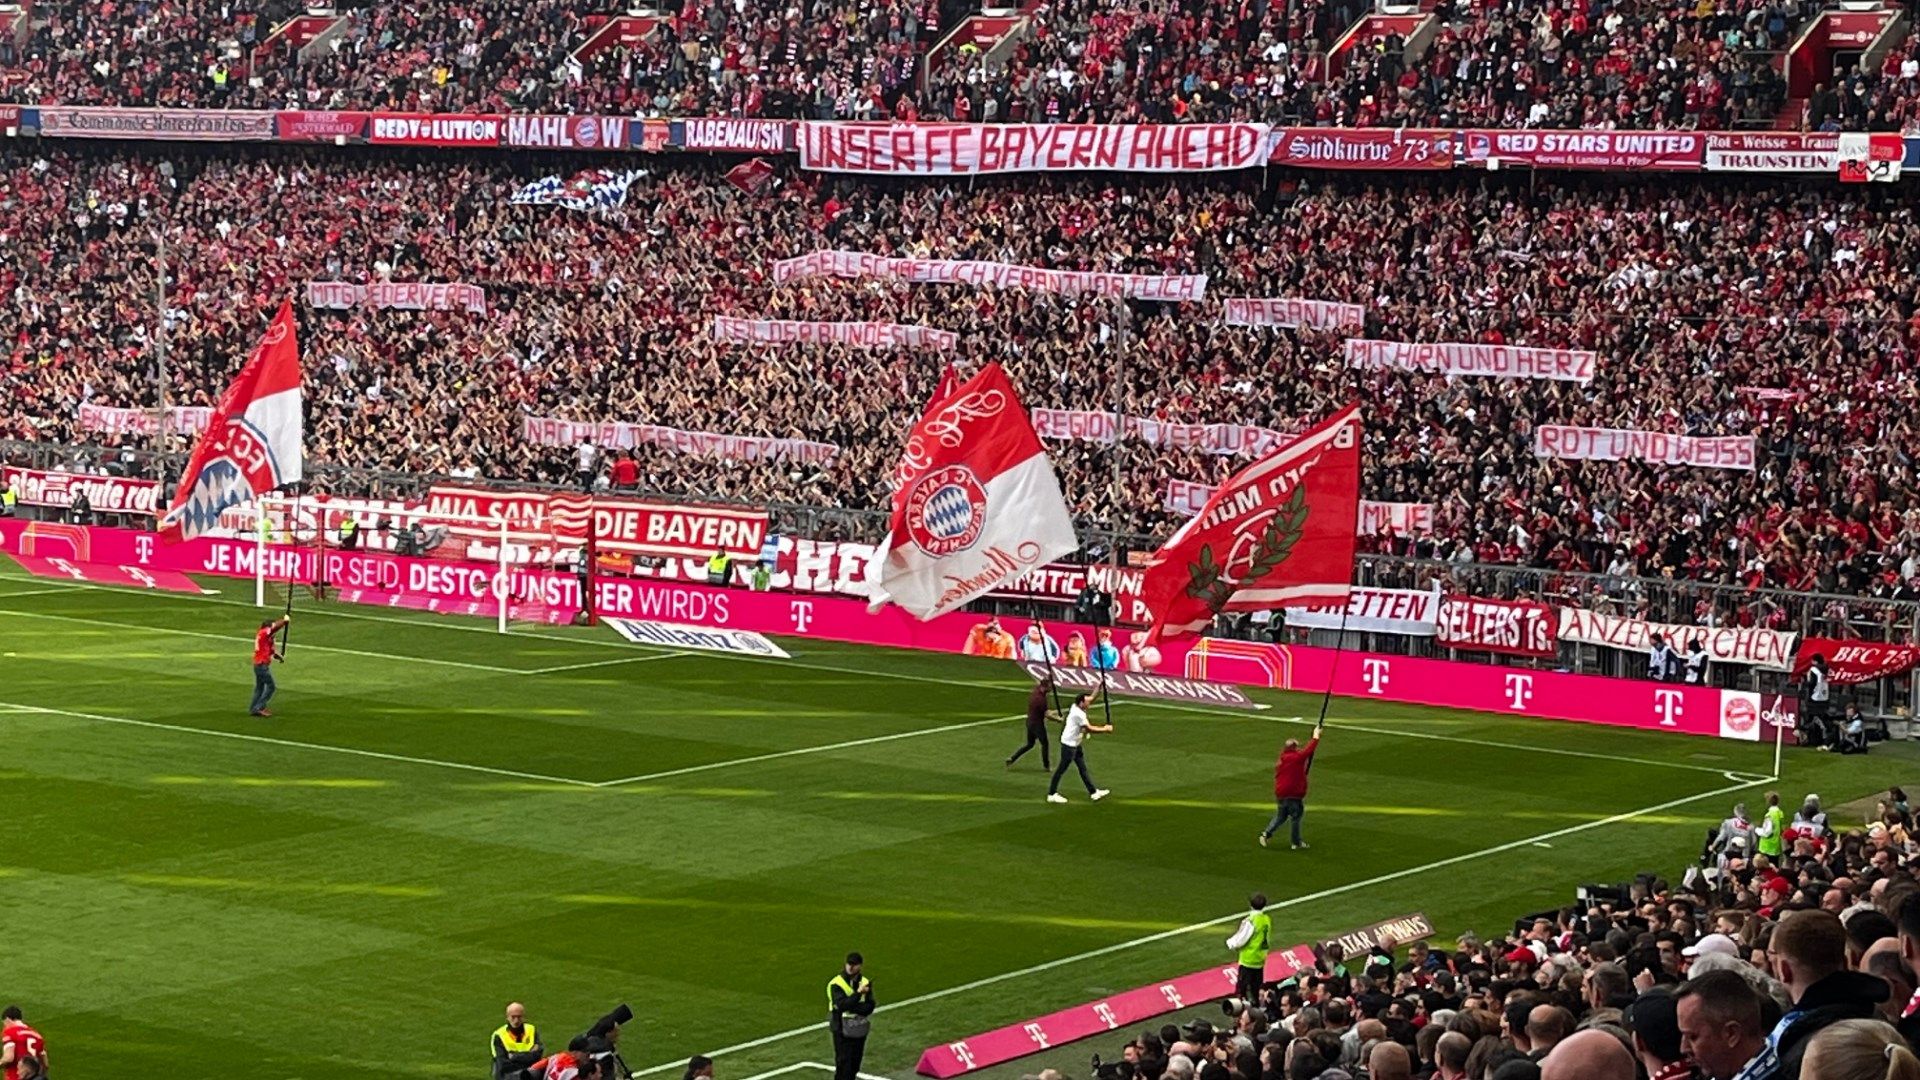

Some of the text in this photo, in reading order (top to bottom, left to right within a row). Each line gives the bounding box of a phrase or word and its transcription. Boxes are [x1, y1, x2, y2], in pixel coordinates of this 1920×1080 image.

[805, 122, 1259, 172] UNSER FC BAYERN AHEAD
[1288, 135, 1393, 162] Südkurve
[1497, 134, 1695, 153] RED STARS UNITED
[1709, 135, 1730, 149] Rot
[1743, 135, 1787, 149] Weisse
[1719, 154, 1829, 168] TRAUNSTEIN
[720, 318, 758, 340] TEIL
[1229, 299, 1360, 327] MIA SAN MIA
[1350, 341, 1593, 378] MIT HIRN UND HERZ
[1541, 427, 1753, 465] ROT UND WEISS
[431, 496, 544, 529] MIA SAN
[594, 510, 760, 551] DIE BAYERN
[204, 544, 231, 571] JE
[235, 546, 301, 580] MEHR
[306, 556, 342, 582] IHR
[409, 564, 489, 598] DESTO
[638, 586, 729, 623] WIRD'S
[622, 618, 734, 649] Allianz
[1437, 599, 1520, 648] SELTERS
[1831, 646, 1881, 664] BFC
[1026, 664, 1246, 702] QATAR AIRWAYS
